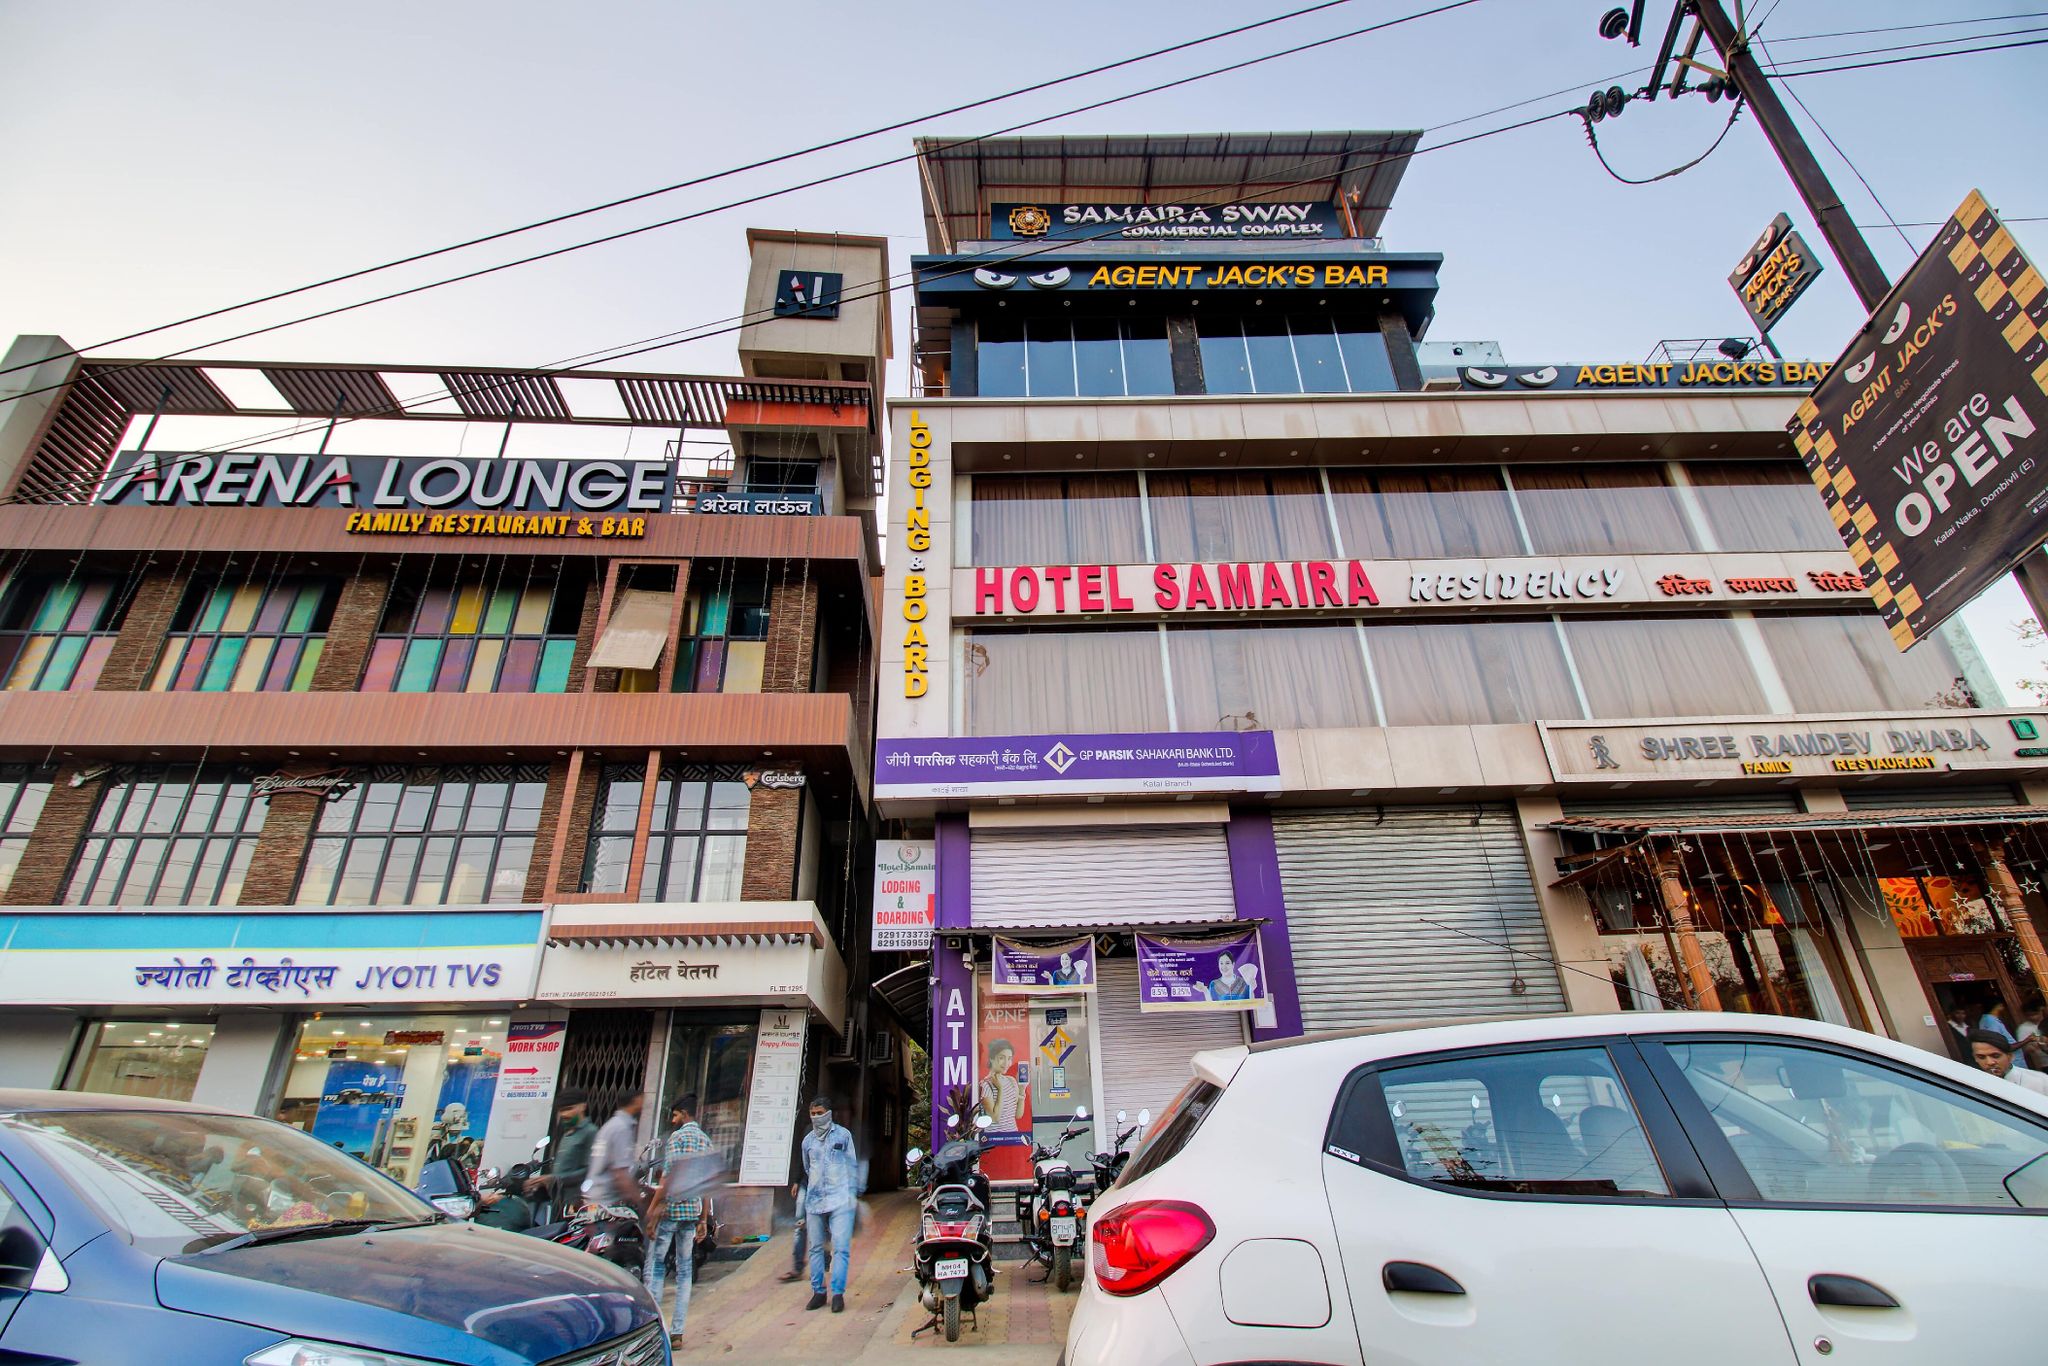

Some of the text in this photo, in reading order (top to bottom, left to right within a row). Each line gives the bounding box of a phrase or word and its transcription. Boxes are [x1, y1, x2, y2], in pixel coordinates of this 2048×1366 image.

[1064, 203, 1313, 224] SAMAIRA SWAY
[1121, 222, 1324, 238] COMMERCIAL COMPLEX
[1088, 265, 1389, 288] AGENT JACK'S BAR
[1746, 239, 1792, 303] AGENT
[1755, 252, 1800, 313] JACK'S
[1775, 285, 1795, 308] BAR
[1576, 364, 1673, 385] AGENT
[1681, 363, 1777, 384] JACK'S
[1841, 293, 1958, 436] AGENT JACK'S
[1894, 378, 1912, 399] BAR
[1891, 392, 1990, 486] We are
[1894, 394, 2037, 537] OPEN
[101, 453, 667, 510] ARENA LOUNGE
[700, 494, 813, 514] अरेना लाऊंज
[1933, 526, 1956, 547] Katai
[1955, 506, 1983, 530] Naka,
[1980, 470, 2019, 507] Dombivli
[2019, 457, 2036, 475] (E)
[345, 512, 646, 537] FAMILY RESTAURANT & BAR
[903, 409, 933, 699] LODGING & BOARD
[975, 561, 1625, 614] HOTEL SAMAIRA RESIDENCY
[1724, 576, 1797, 595] समायरा
[1079, 748, 1236, 761] GP PARSIK SAHAKARI BANK LTD.
[1640, 728, 1991, 761] SHREE RAMDEV DHABA
[886, 752, 911, 767] जीपी
[913, 752, 956, 767] पारसिक
[959, 751, 999, 767] सहकारी
[1023, 749, 1041, 764] लि.
[1742, 756, 1937, 775] FAMILY RESTAURANT
[253, 776, 344, 790] Budweiser
[761, 770, 806, 789] Carlsberg
[1165, 779, 1192, 788] Branch
[879, 863, 904, 873] Hotel
[881, 880, 921, 893] LODGING
[897, 895, 904, 909] &
[877, 911, 924, 925] BOARDING
[136, 957, 339, 998] ज्योती टीव्हीएस
[356, 962, 503, 990] JYOTI TVS
[630, 960, 720, 983] हॉटेल चेतना
[529, 1023, 546, 1031] TVS
[984, 1009, 1027, 1024] APNE
[508, 1042, 560, 1053] WORK SHOP
[760, 1040, 780, 1049] Happy
[943, 988, 968, 1086] ATM
[1334, 1147, 1356, 1159] RXT
